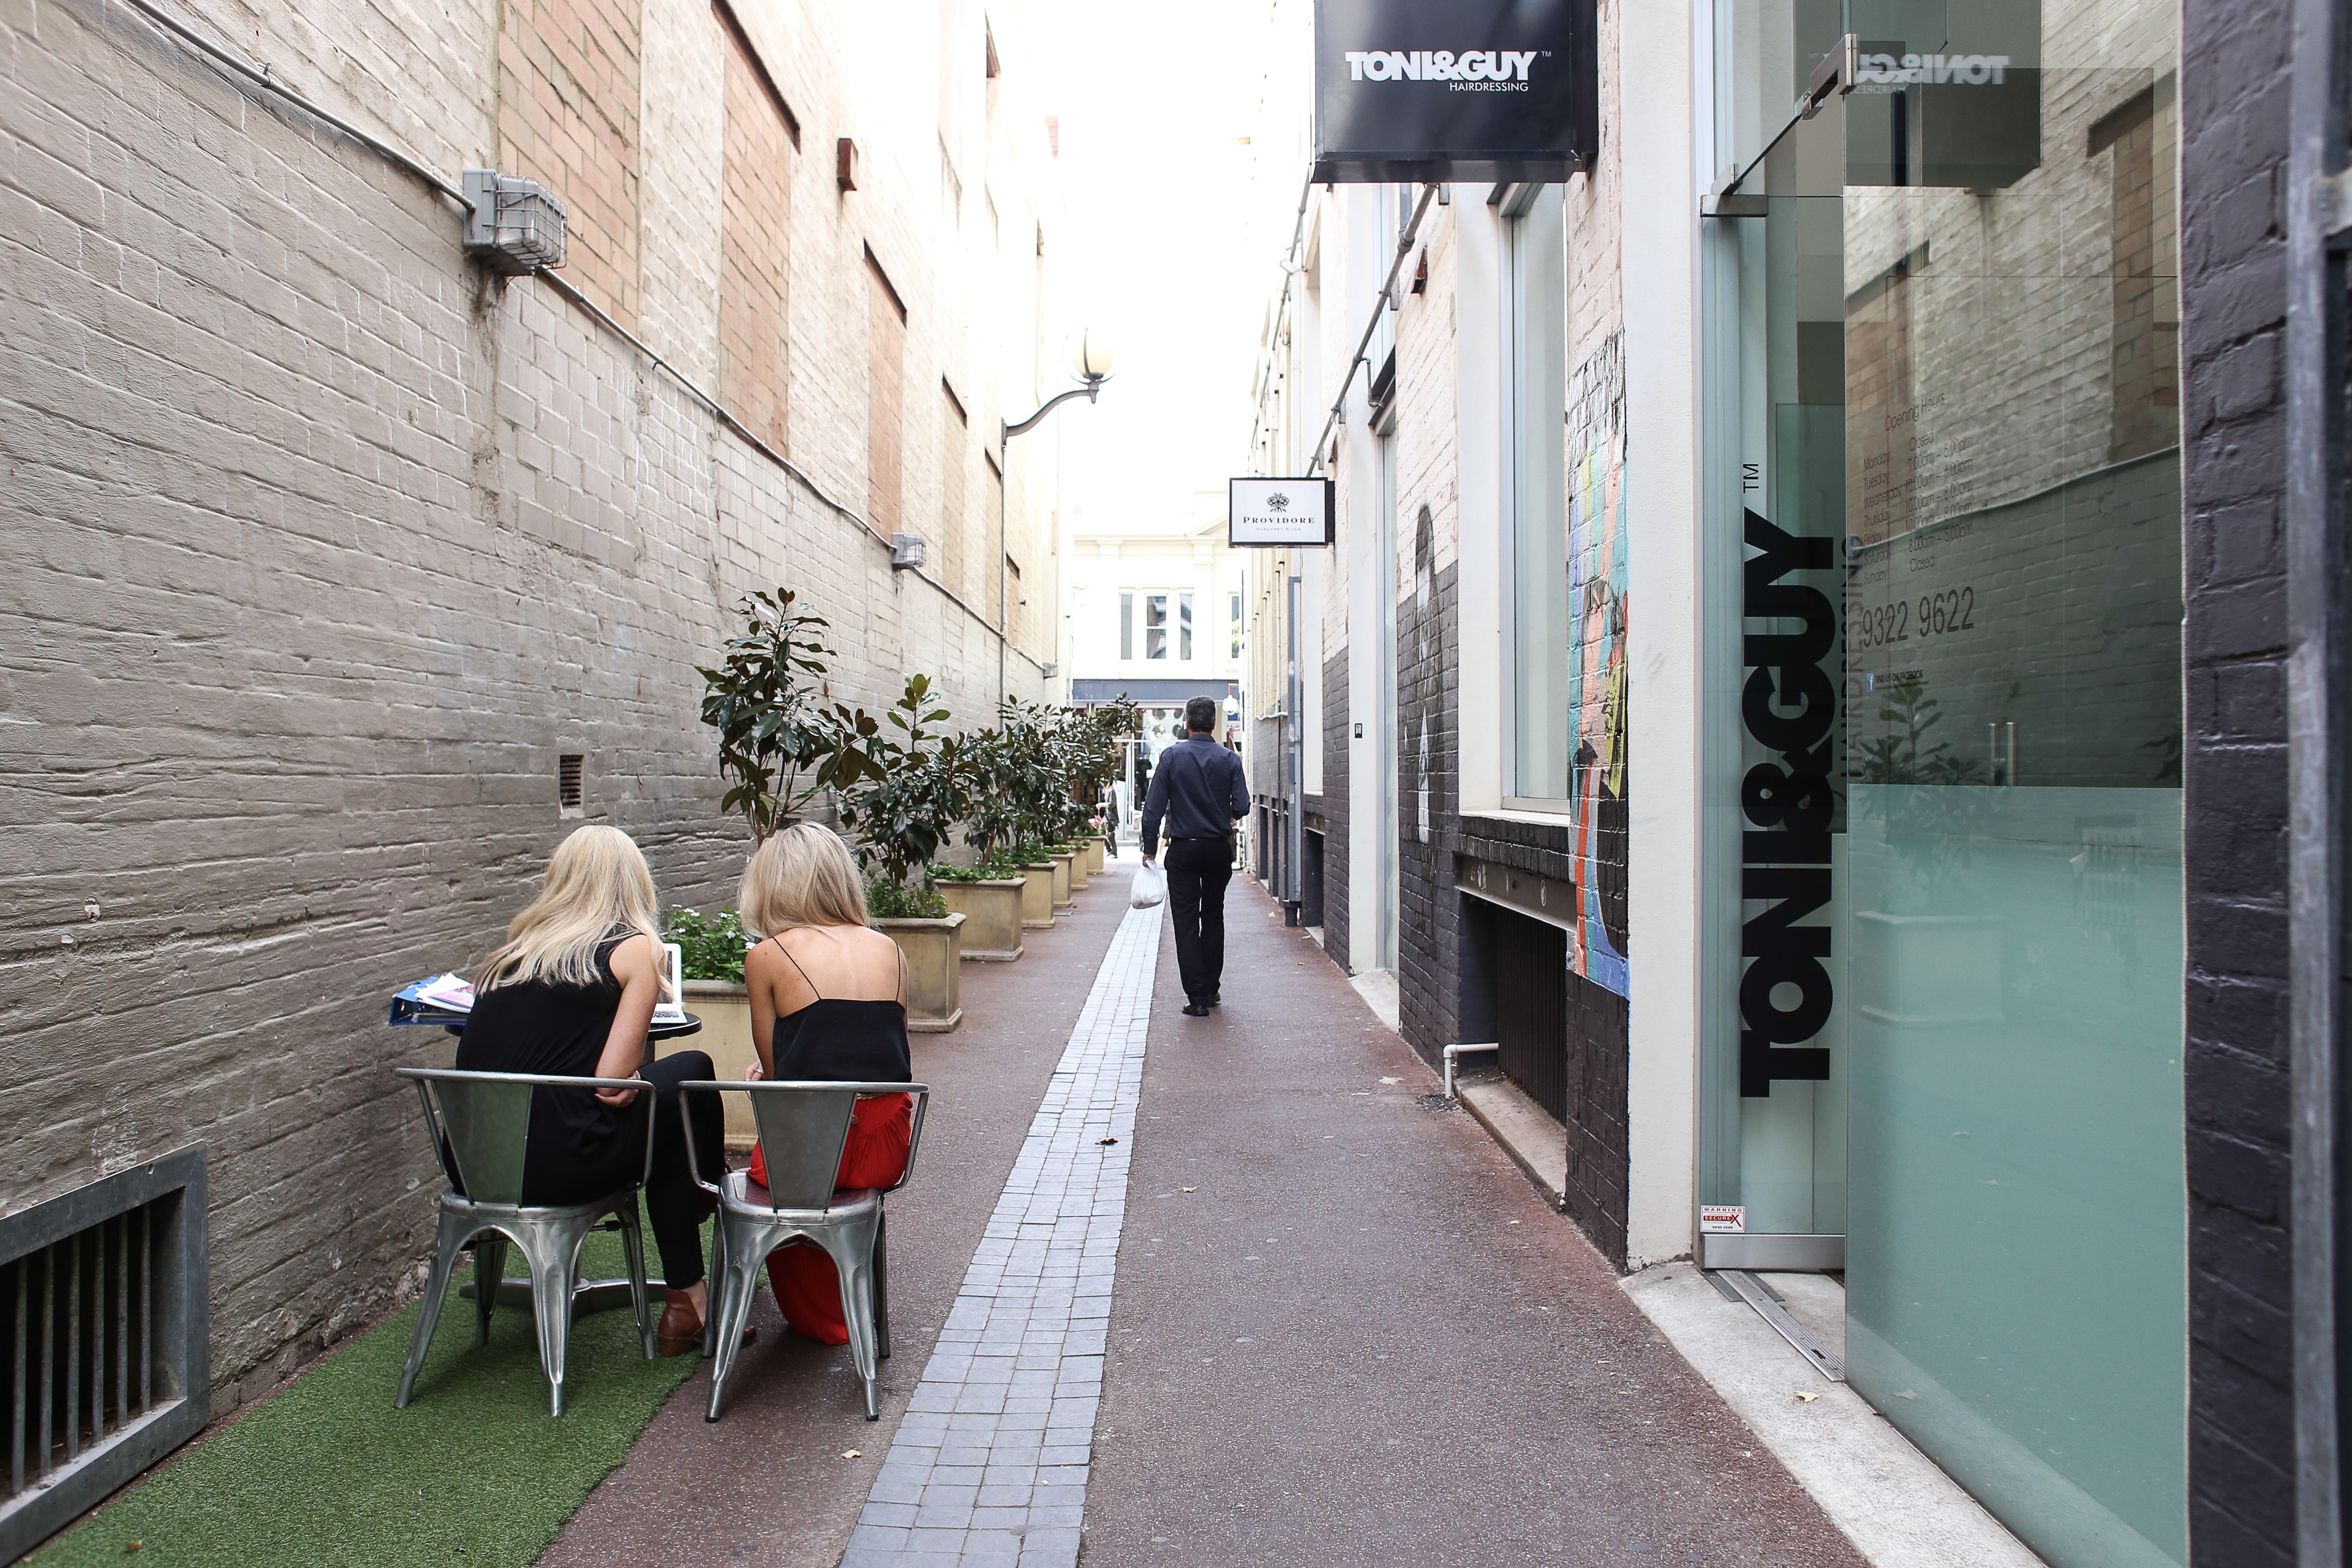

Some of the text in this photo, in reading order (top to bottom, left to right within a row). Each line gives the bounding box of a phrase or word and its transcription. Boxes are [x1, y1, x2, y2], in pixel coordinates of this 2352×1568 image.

[1345, 50, 1537, 81] TONI&GUY
[1450, 83, 1528, 92] HAIRDRESSING
[1885, 392, 1945, 432] Opening Hours
[1864, 429, 1934, 471] Monday Closed
[1864, 472, 1888, 490] Tuesday
[1864, 486, 1901, 509] Wednesday
[1864, 510, 1890, 527] Thursday
[1864, 532, 1883, 546] Friday
[1864, 548, 1891, 566] Saturday
[1864, 553, 1934, 585] Sunday Closed
[1863, 586, 1974, 648] 9322 9622
[1875, 669, 1923, 683] FIND US ON FACEBOOK
[1739, 506, 1836, 1098] TONI&GUY
